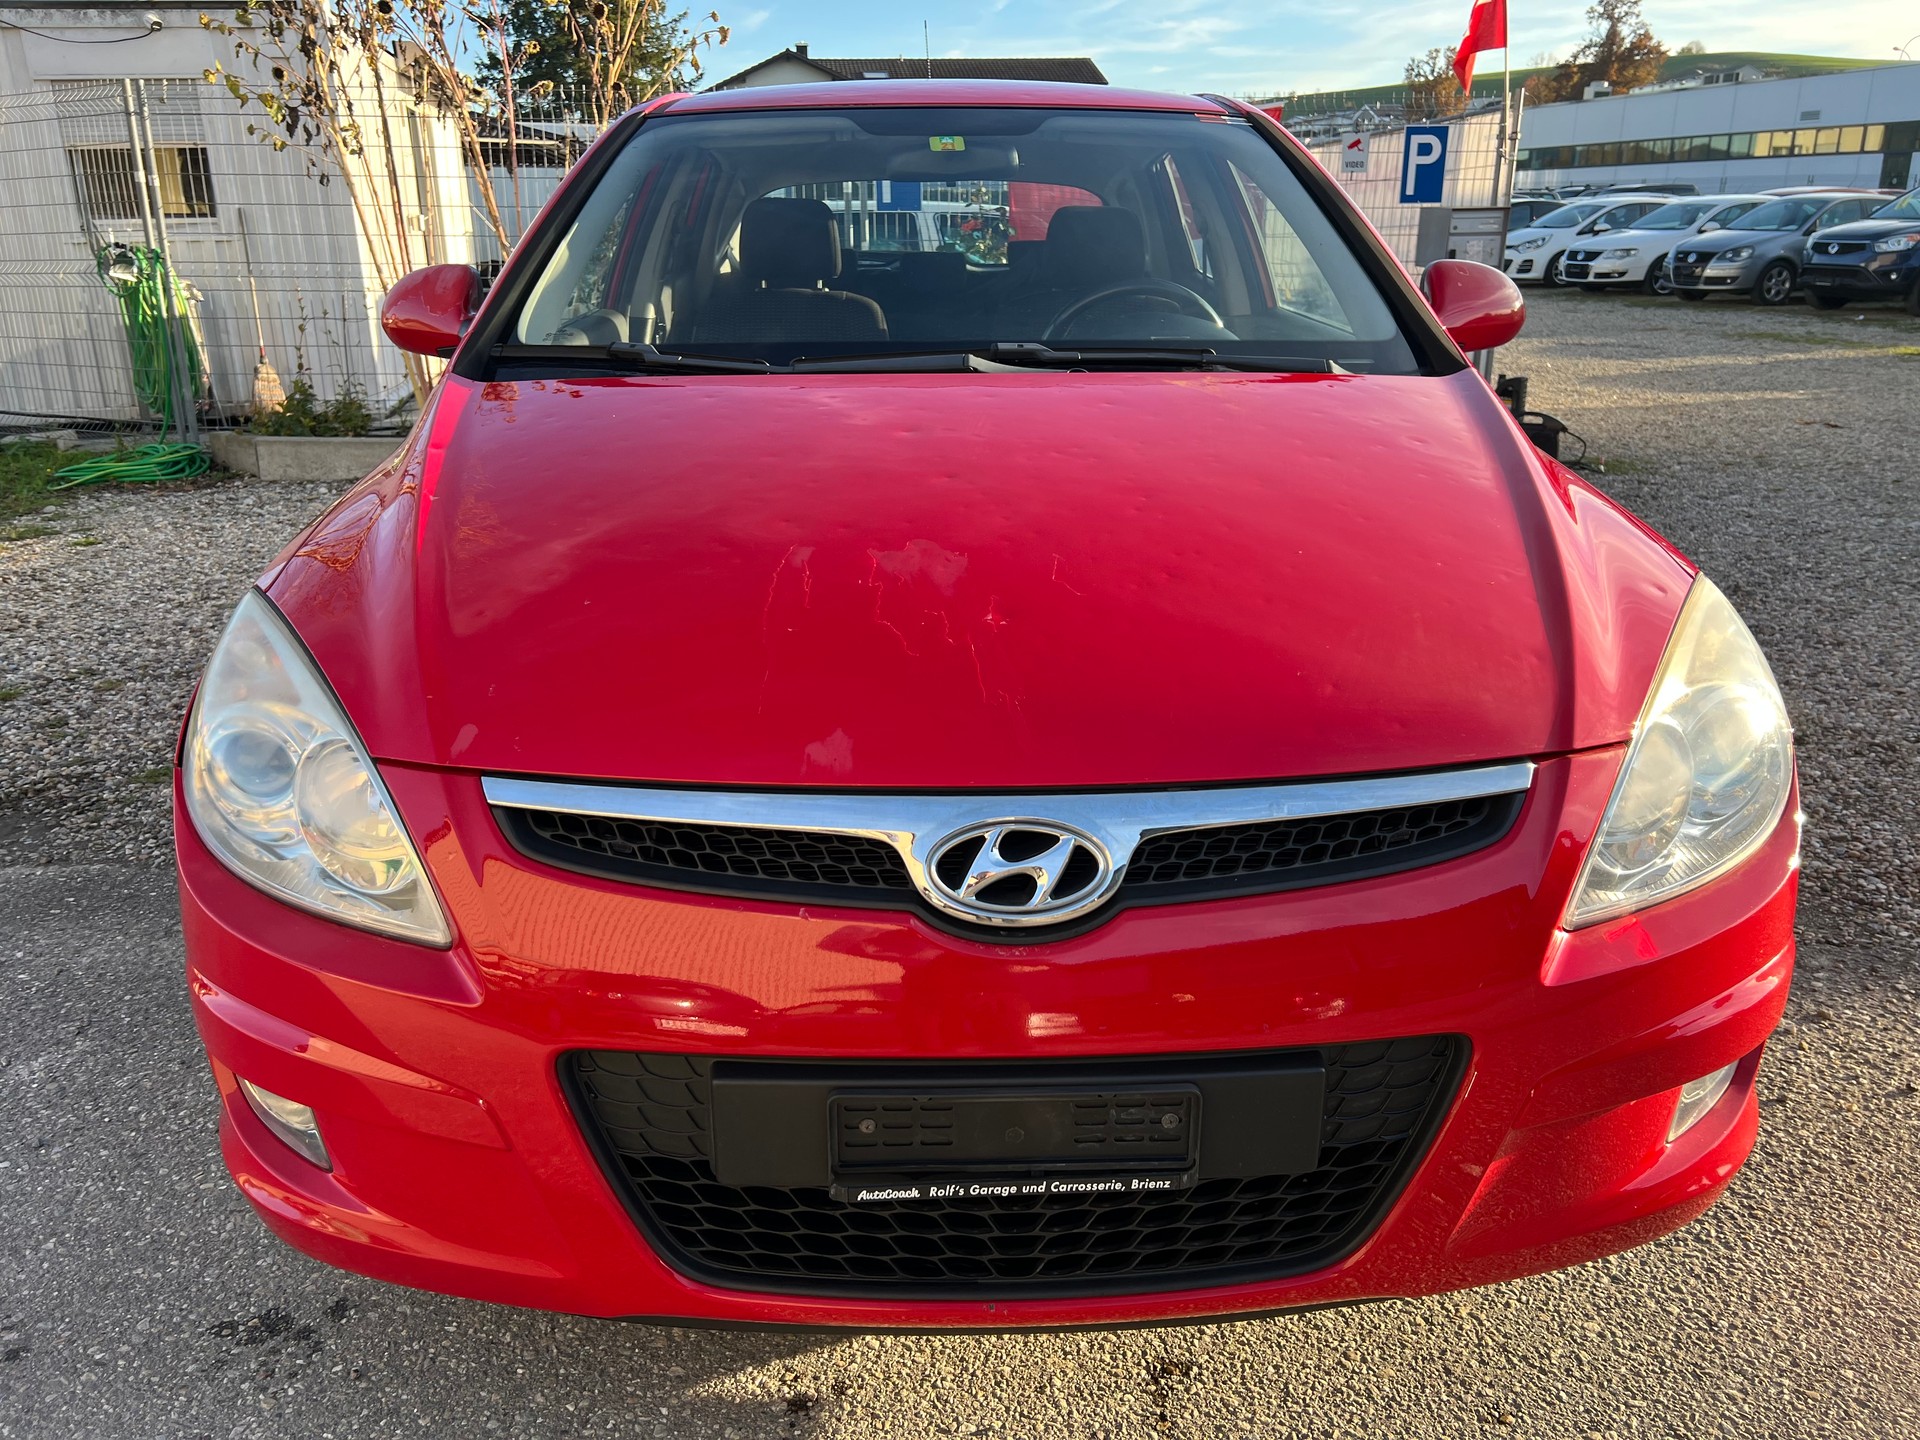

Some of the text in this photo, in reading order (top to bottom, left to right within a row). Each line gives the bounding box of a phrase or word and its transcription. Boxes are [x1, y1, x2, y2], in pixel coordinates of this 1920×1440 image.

[1344, 160, 1365, 169] VIDEO
[1405, 134, 1442, 196] P
[857, 1178, 1171, 1201] AutoCoach Rolf's Garage und Carrosserie, Brienz
